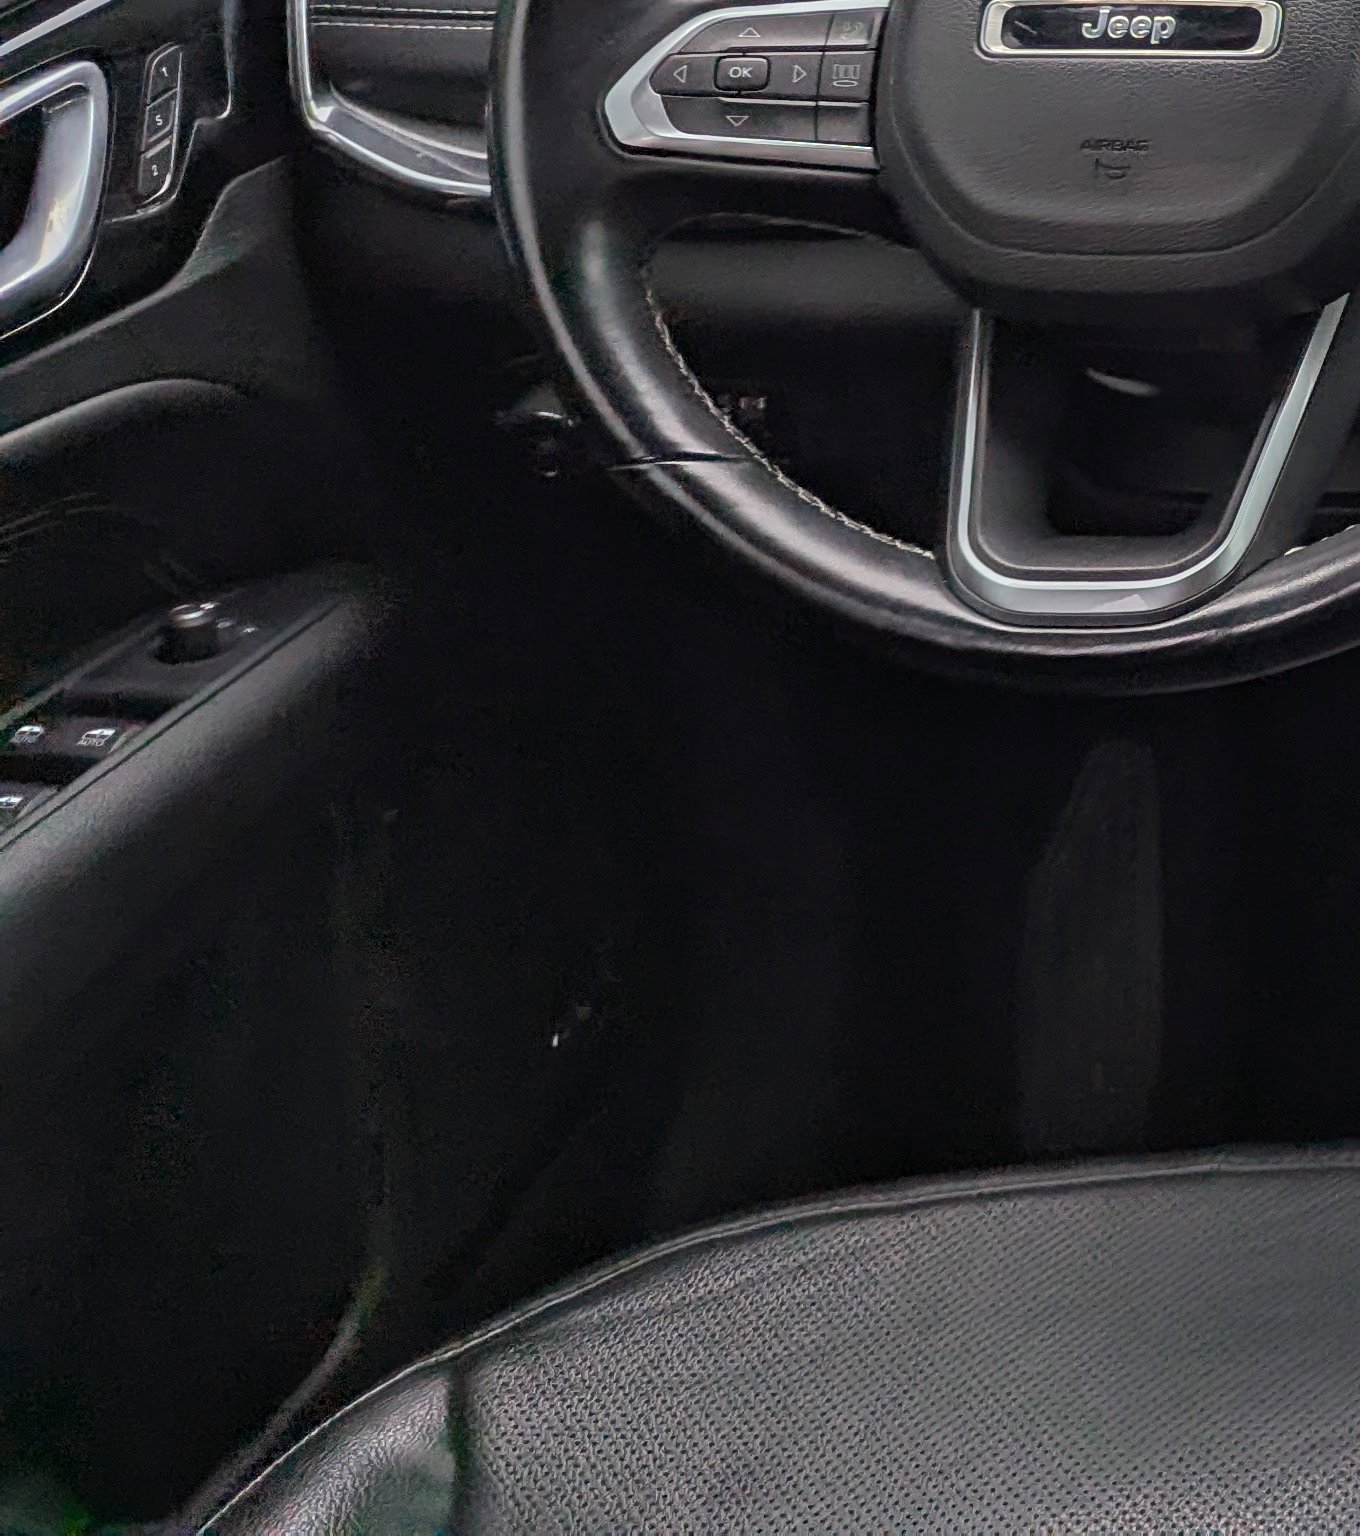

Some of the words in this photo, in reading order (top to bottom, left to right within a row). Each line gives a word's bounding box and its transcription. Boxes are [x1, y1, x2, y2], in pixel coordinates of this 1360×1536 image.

[1081, 7, 1177, 44] Jeep
[162, 67, 169, 77] 1
[728, 66, 752, 78] OK
